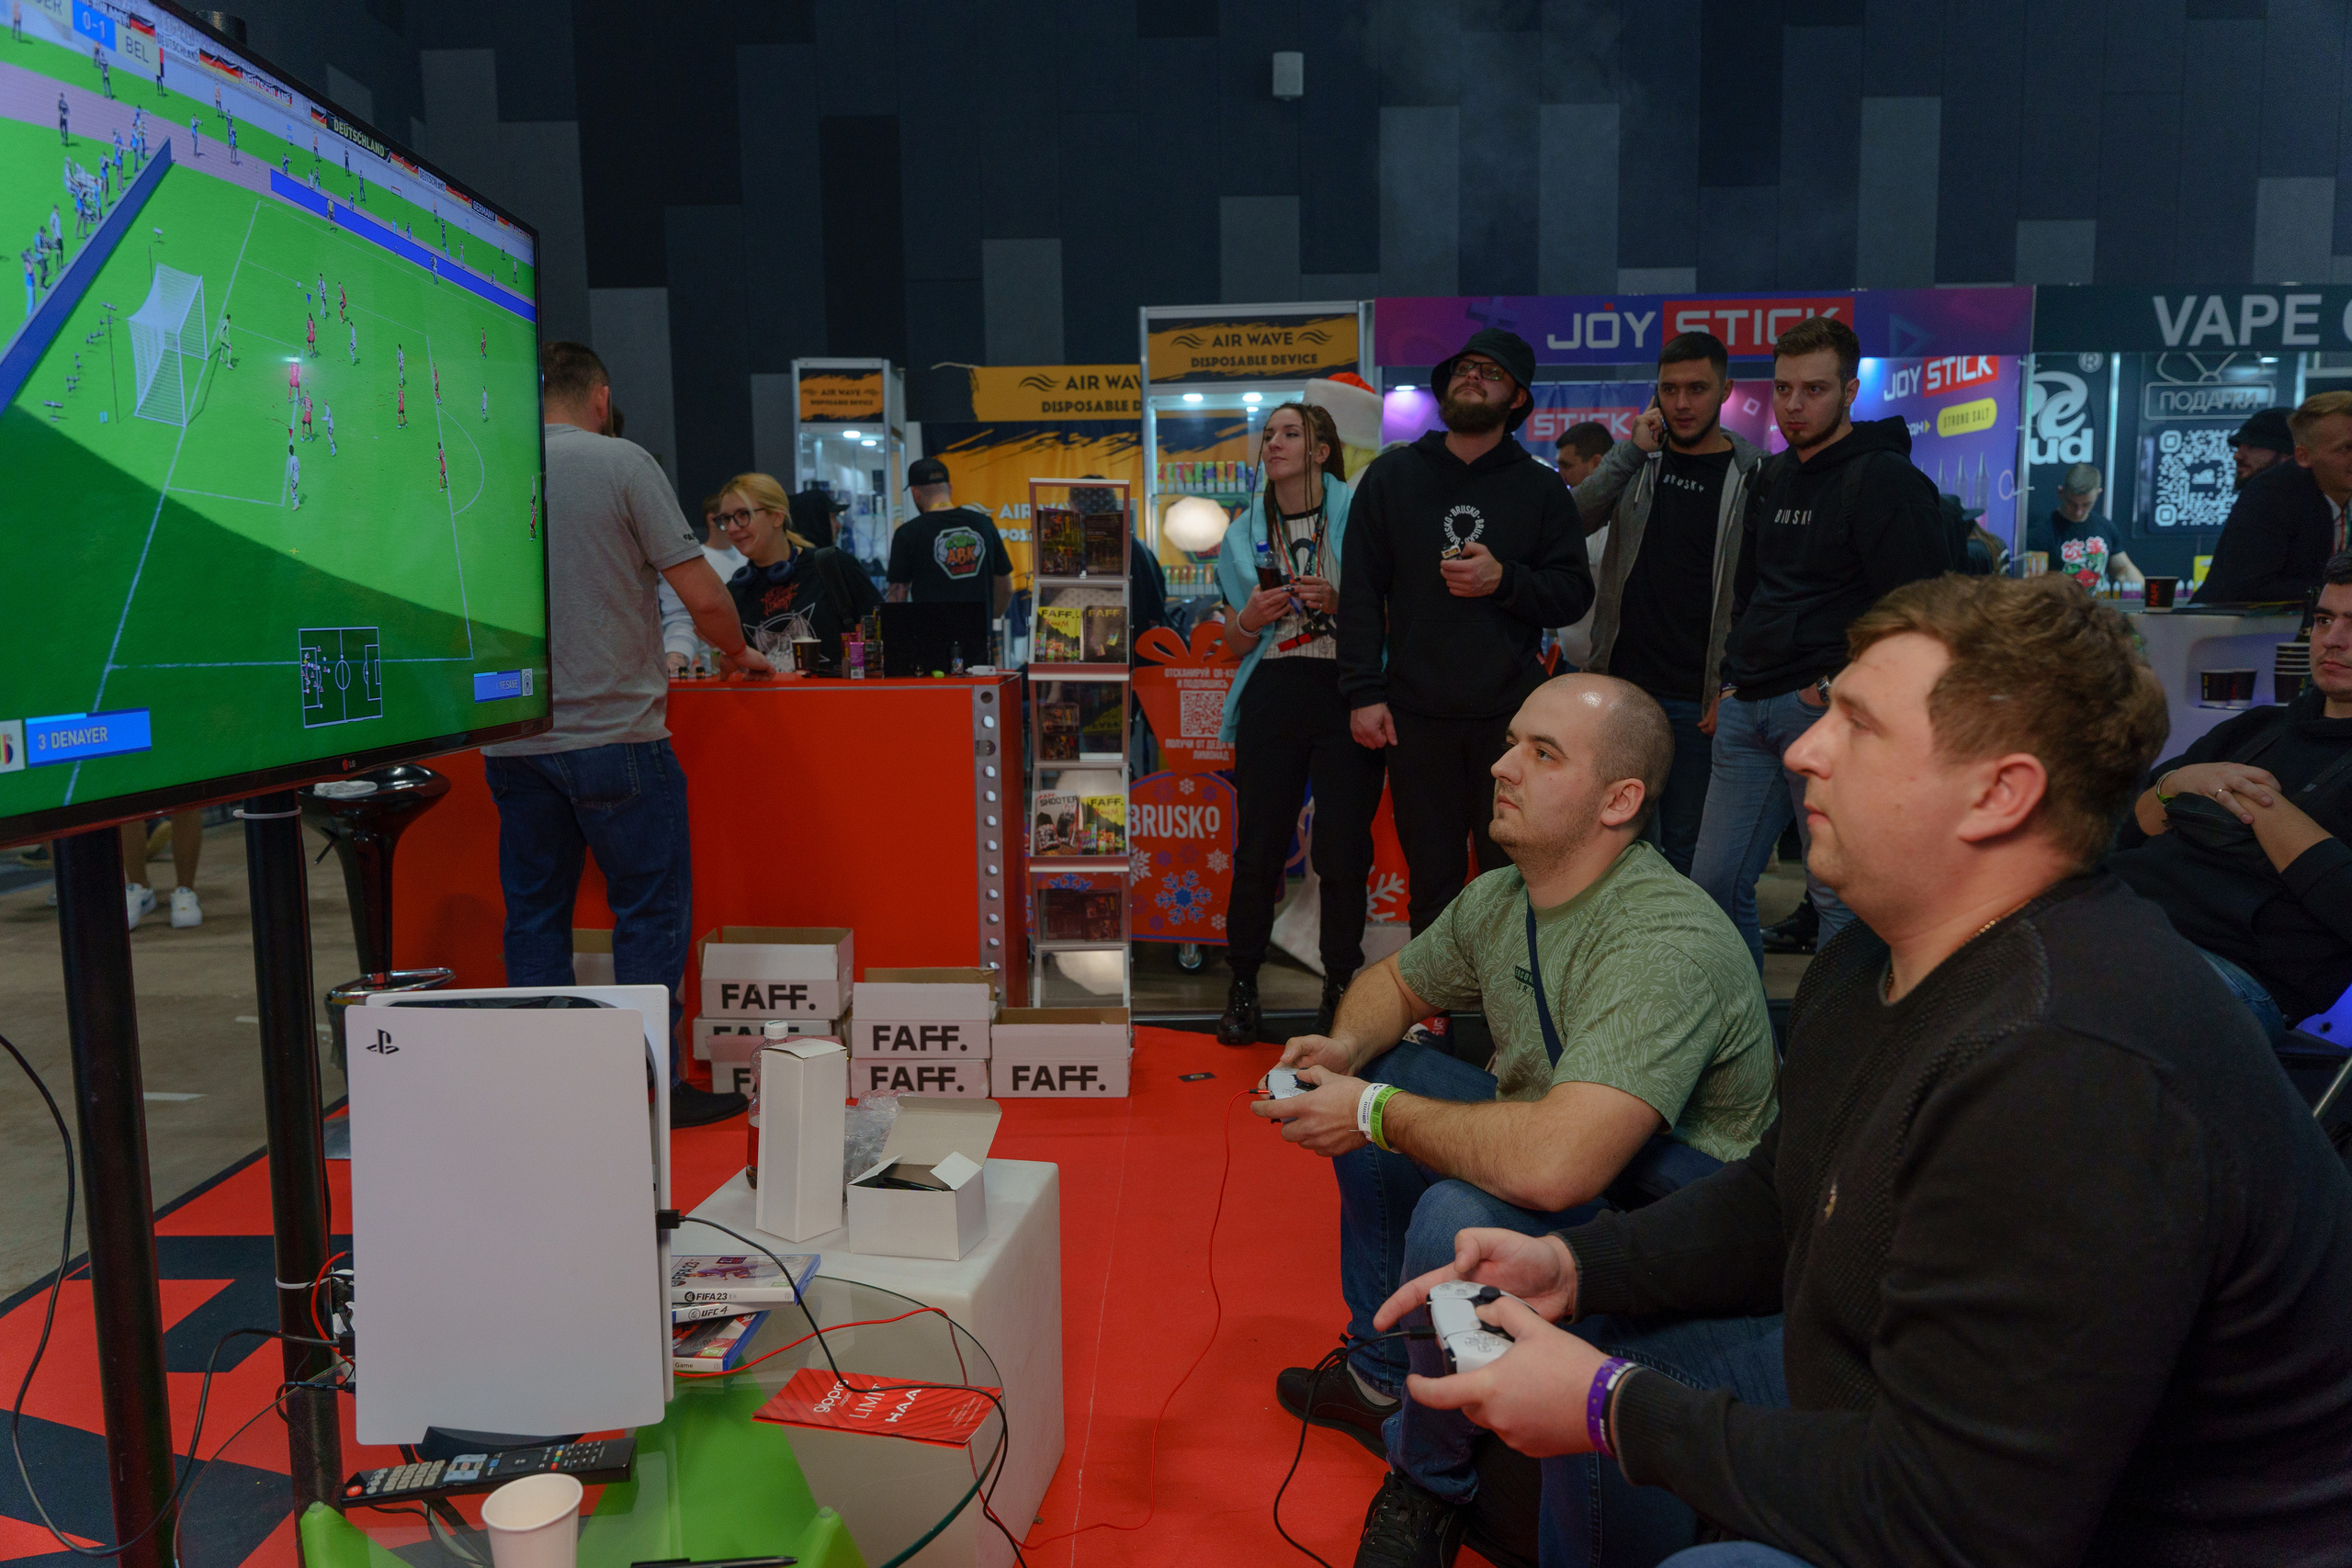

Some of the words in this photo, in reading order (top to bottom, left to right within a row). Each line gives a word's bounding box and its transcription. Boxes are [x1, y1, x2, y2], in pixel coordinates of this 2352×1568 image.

[82, 11, 106, 39] 0-1
[126, 35, 149, 63] BEL
[334, 118, 385, 159] DEUTSCHLAND
[472, 200, 496, 221] GERMANY
[1546, 304, 1657, 350] JOY
[1675, 307, 1840, 346] STIC
[2153, 293, 2323, 347] VAPE
[1212, 333, 1242, 347] AIR
[1247, 332, 1294, 346] WAVE
[1192, 355, 1268, 367] DISPOSABLE
[1271, 353, 1317, 366] DEVICE
[1065, 375, 1100, 390] AIR
[1883, 364, 1922, 401] JOY
[1927, 355, 1993, 390] STICK
[1042, 400, 1129, 413] DISPOSABLE
[2160, 390, 2260, 414] ПОДАРКИ
[1943, 412, 1970, 429] STRONG
[1972, 407, 1990, 423] SALT
[1450, 504, 1481, 518] BRUSKO
[38, 733, 47, 750] 3
[51, 726, 108, 750] DENAYER
[348, 760, 356, 768] LG
[1129, 803, 1221, 840] BRUSKO
[721, 983, 817, 1011] FAFF.
[872, 1024, 968, 1053] FAFF.
[870, 1066, 965, 1092] FAFF.
[1012, 1065, 1107, 1092] FAFF.
[695, 1292, 716, 1301] FIFA
[716, 1292, 728, 1301] 23
[701, 1308, 719, 1317] UFC
[720, 1305, 729, 1314] 4
[849, 1382, 886, 1419] LIMIT
